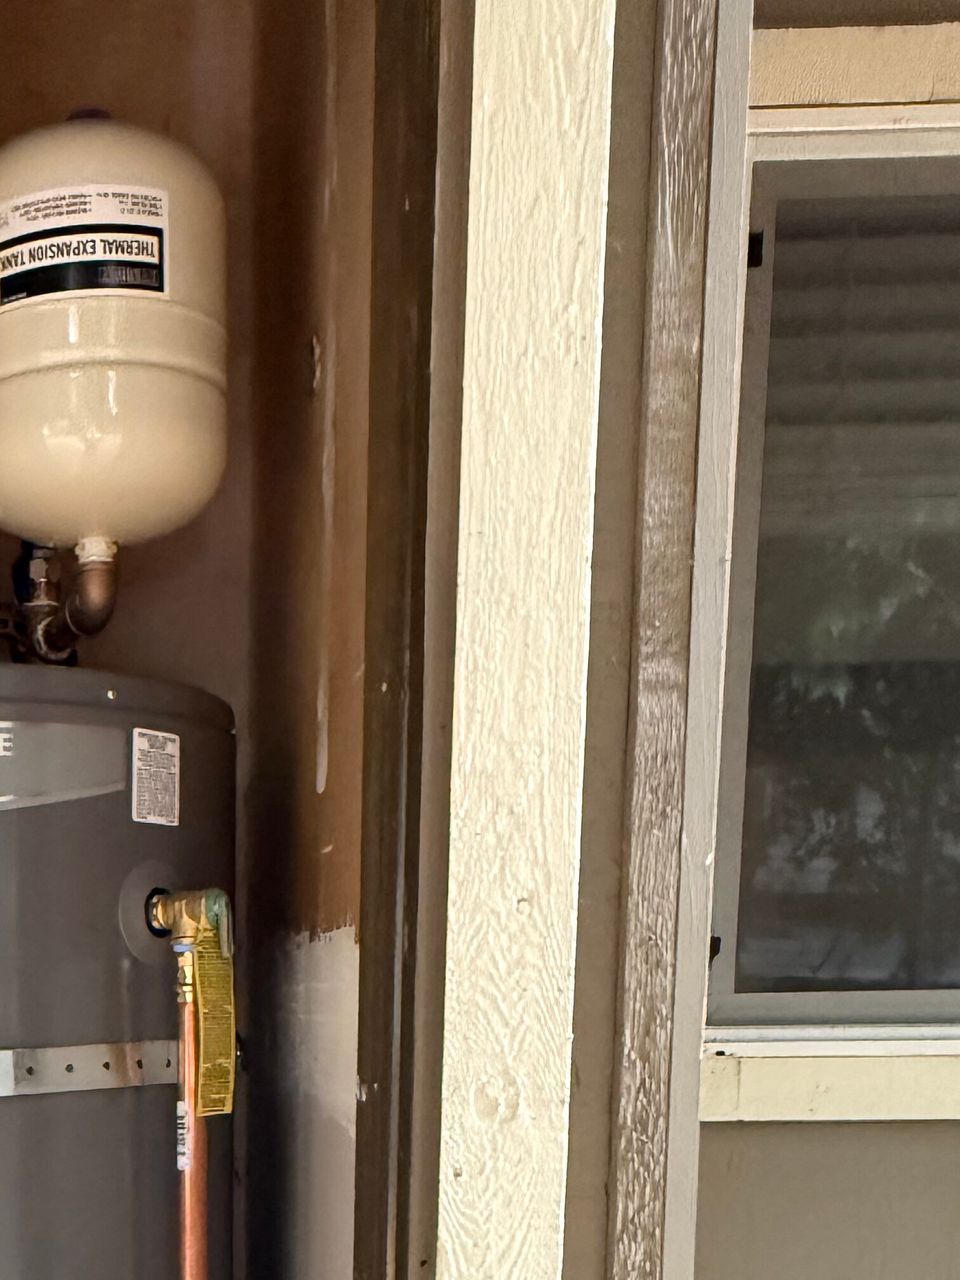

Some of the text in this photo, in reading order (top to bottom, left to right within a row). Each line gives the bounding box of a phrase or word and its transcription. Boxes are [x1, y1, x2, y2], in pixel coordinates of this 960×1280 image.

[0, 238, 155, 273] THERMAL EXPANSION TANK
